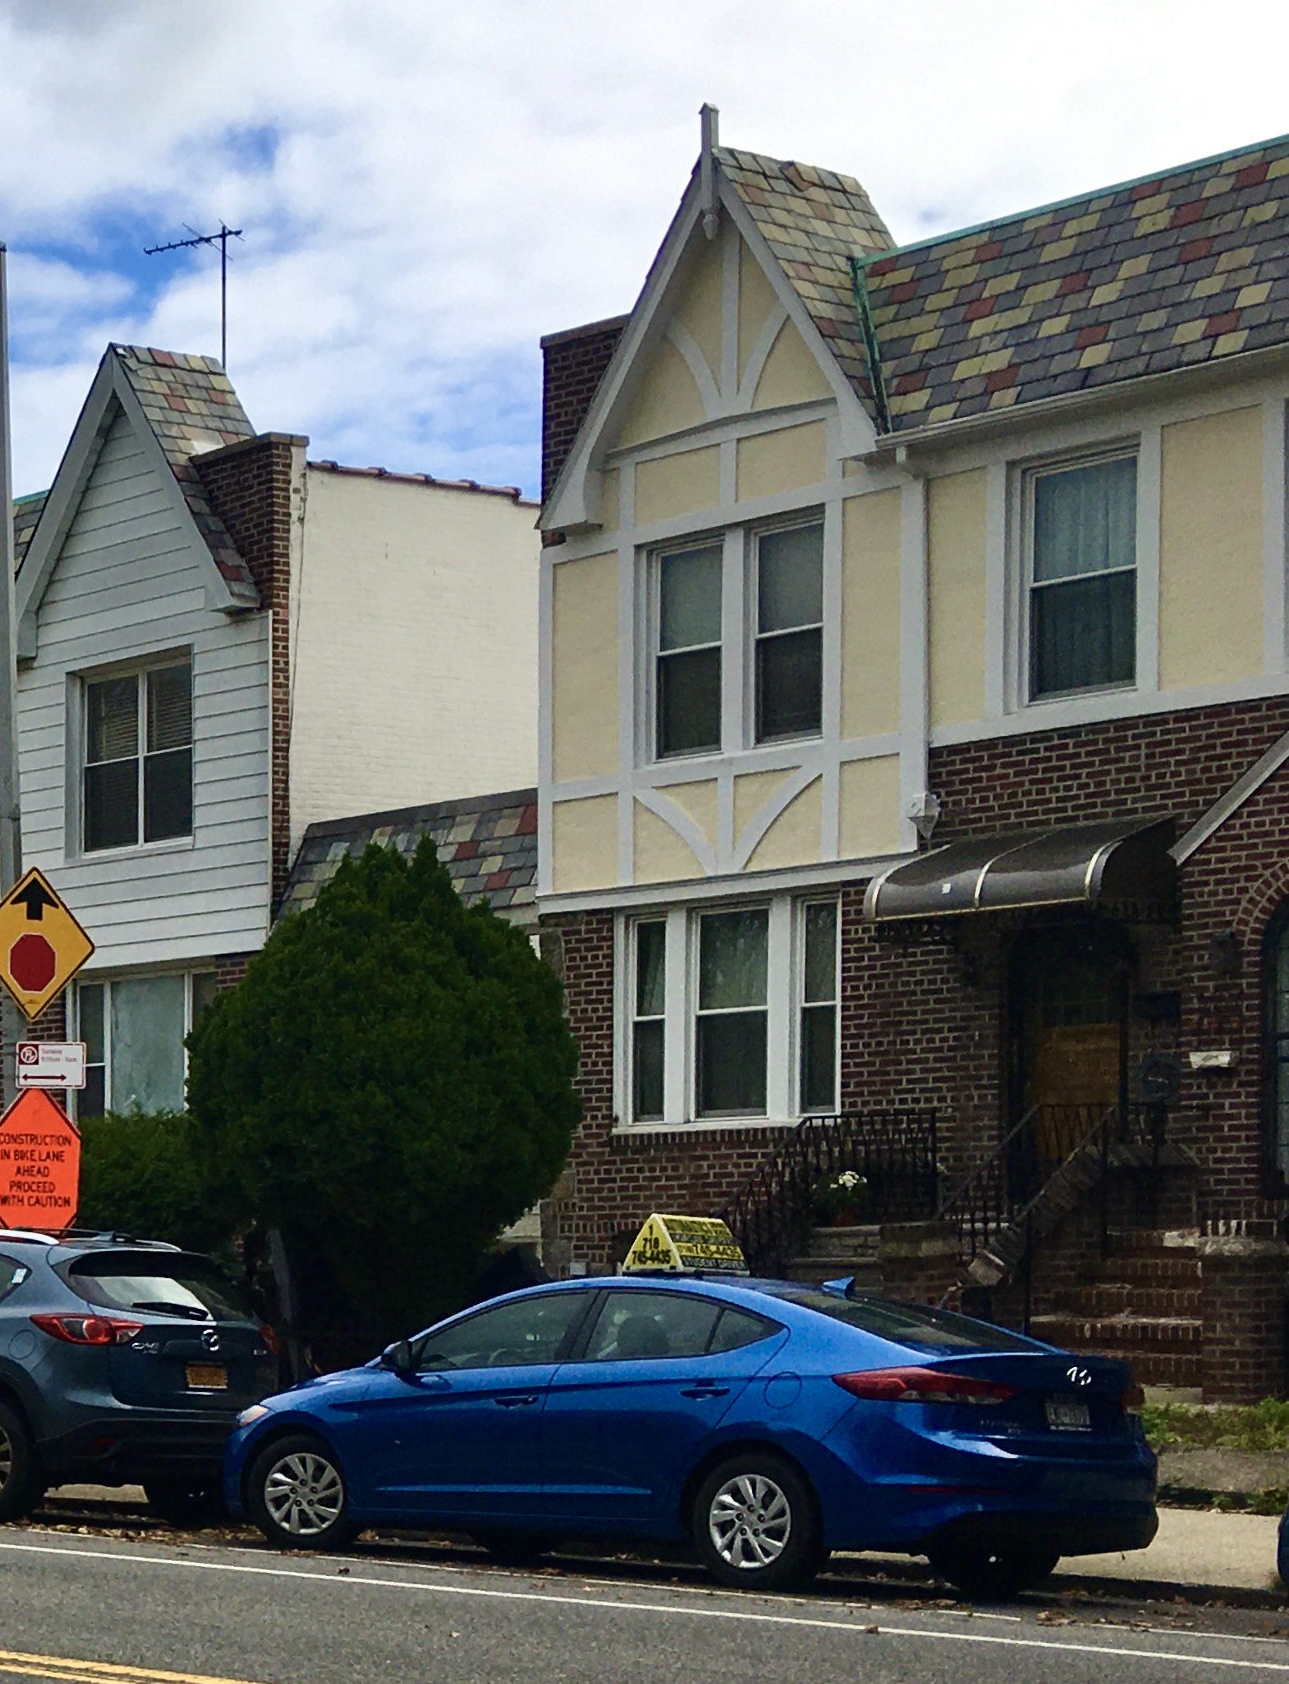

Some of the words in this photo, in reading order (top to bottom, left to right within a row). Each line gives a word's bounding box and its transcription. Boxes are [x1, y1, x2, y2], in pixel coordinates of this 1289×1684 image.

[0, 1148, 11, 1160] IN
[13, 1149, 37, 1162] BIKE
[38, 1150, 66, 1162] LANE
[14, 1165, 50, 1177] AHEAD
[9, 1180, 56, 1193] PROCEED
[0, 1194, 25, 1207] WITH
[27, 1195, 71, 1208] CAUTION
[642, 1237, 661, 1251] 718
[631, 1249, 673, 1266] 745-4435
